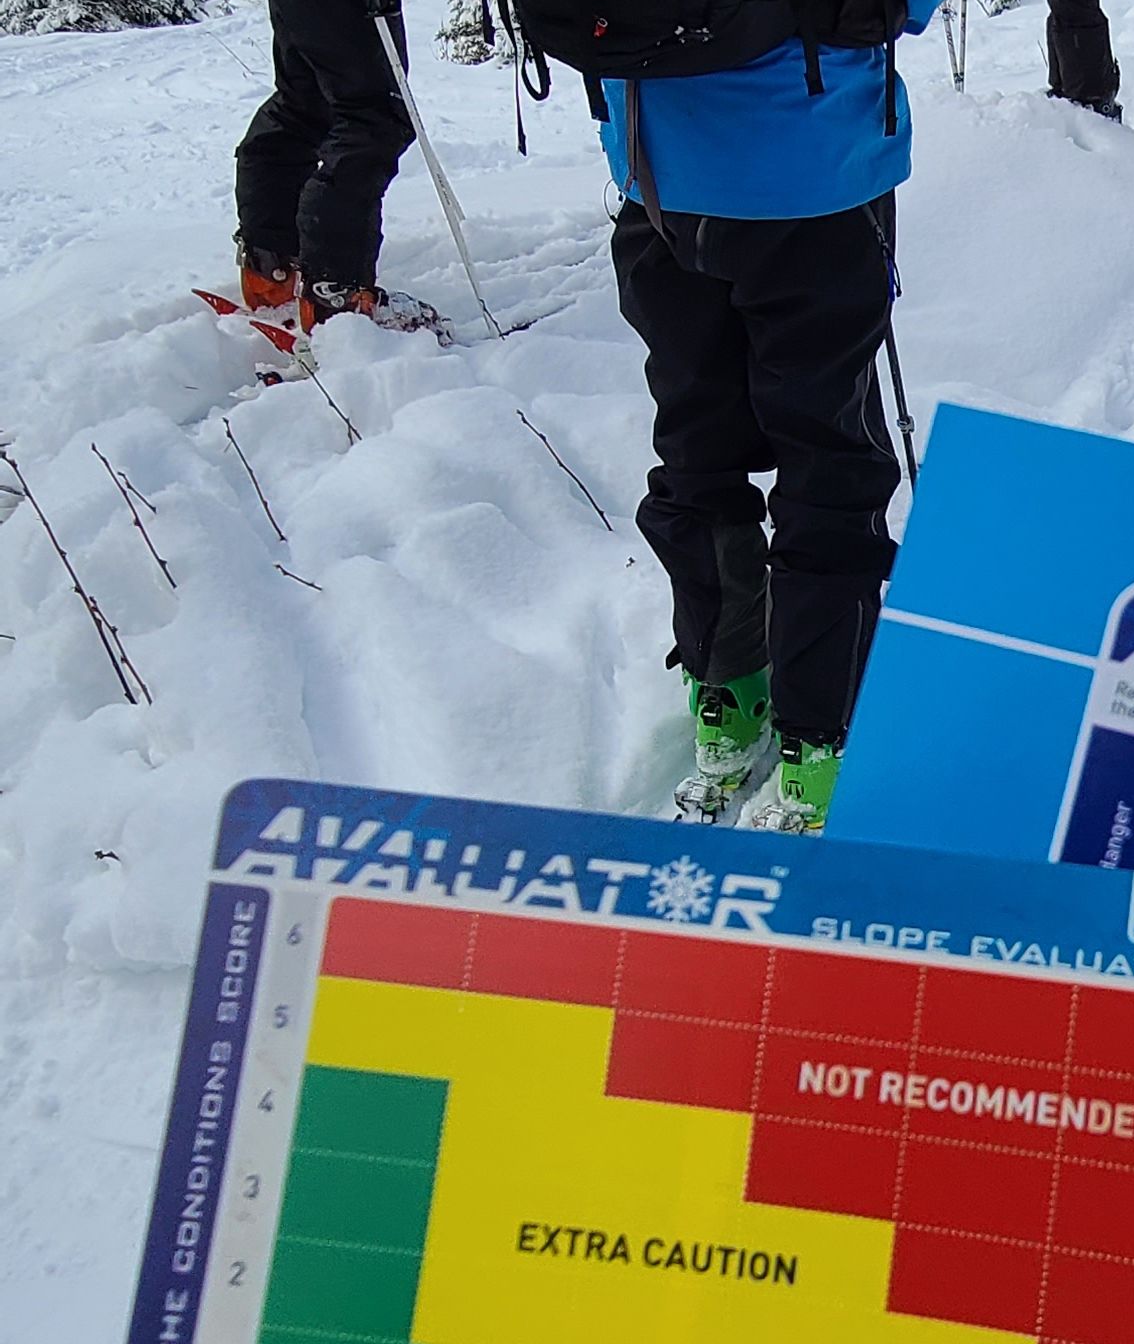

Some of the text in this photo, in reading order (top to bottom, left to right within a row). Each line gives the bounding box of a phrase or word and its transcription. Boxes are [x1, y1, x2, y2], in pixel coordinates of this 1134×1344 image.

[286, 922, 303, 947] 6
[811, 916, 951, 954] SLOPE
[273, 1004, 289, 1029] 5
[171, 1040, 232, 1274] CONDITIONS
[216, 900, 258, 1025] SCORE
[798, 1061, 872, 1101] NOT
[257, 1087, 274, 1114] 4
[243, 1174, 261, 1199] 3
[517, 1222, 798, 1285] EXTRA CAUTION
[228, 1260, 247, 1287] 2
